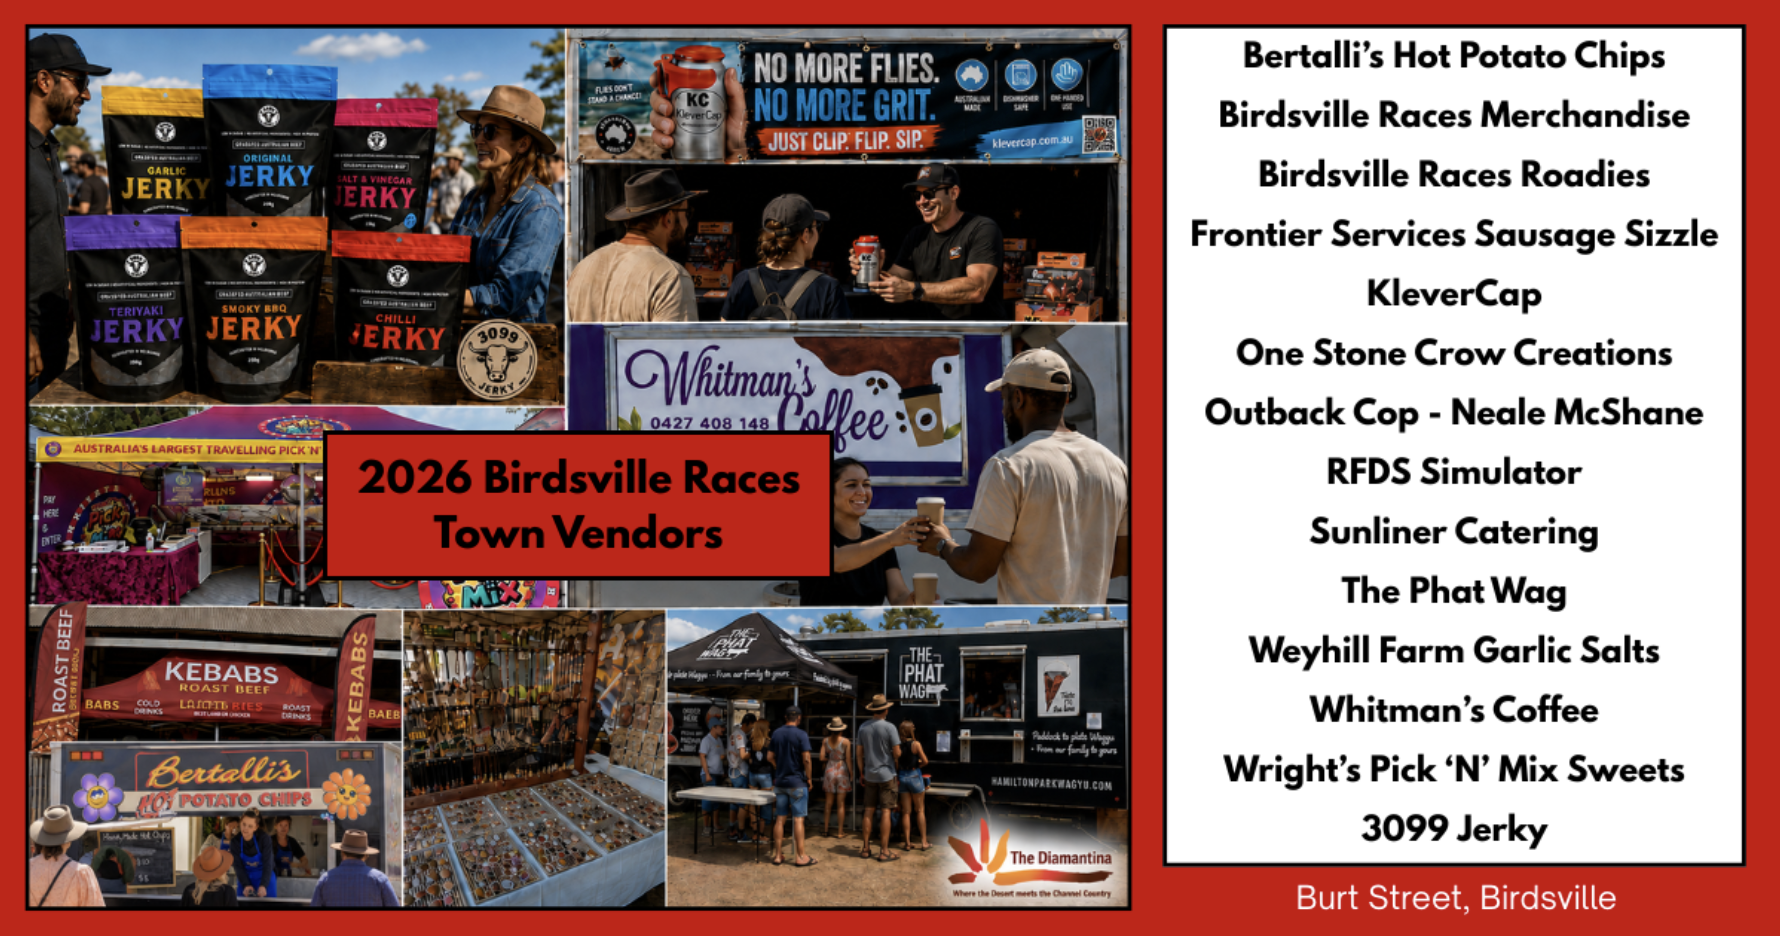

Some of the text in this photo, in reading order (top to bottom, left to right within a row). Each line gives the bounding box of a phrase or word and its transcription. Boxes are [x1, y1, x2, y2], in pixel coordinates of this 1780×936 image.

[754, 52, 940, 83] NO MORE FLIES.
[595, 85, 613, 94] FLIES
[686, 92, 709, 107] KC
[754, 87, 936, 121] NO MORE GRIT.
[954, 95, 991, 103] AUSTRALIAN
[964, 103, 982, 112] MADE
[1013, 103, 1029, 111] SAFE
[675, 108, 722, 121] KleverCap
[768, 129, 923, 151] JUST CLIP. FLIP. SIP.
[992, 135, 1074, 149] klevercap.com.au
[243, 154, 293, 163] ORIGINAL
[147, 166, 187, 175] GARLIC
[225, 165, 315, 187] JERKY
[337, 175, 413, 185] SALT & VINEGAR
[121, 177, 210, 199] JERKY
[334, 185, 417, 209] JERKY
[109, 305, 164, 317] TERIYAKI
[221, 303, 288, 314] SMOKY BBQ
[375, 313, 417, 324] CHILLI
[90, 317, 184, 343] JERKY
[205, 314, 303, 340] JERKY
[348, 323, 447, 351] JERKY
[477, 327, 519, 344] 3099
[624, 344, 816, 406] Whitman's
[479, 382, 514, 395] JERKY
[650, 417, 769, 430] 0427 408 148
[777, 387, 889, 453] Coffee
[73, 444, 148, 454] AUSTRALIA'S
[152, 444, 203, 455] LARGEST
[206, 445, 276, 455] TRAVELLING
[279, 445, 306, 455] PICK
[43, 495, 56, 504] PAY
[43, 508, 59, 518] HERE
[41, 534, 62, 547] ENTER
[730, 627, 755, 637] THE
[713, 638, 757, 648] PHAT
[52, 609, 73, 713] ROAST BEEF
[909, 646, 933, 663] THE
[164, 661, 279, 684] KEBABS
[905, 663, 944, 683] PHAT
[346, 631, 368, 732] KEBABS
[179, 683, 271, 694] ROAST BEEF
[85, 699, 120, 711] BABS
[137, 699, 160, 707] COLD
[282, 704, 311, 712] ROAST
[133, 707, 163, 716] DRINKS
[281, 712, 311, 721] DRINKS
[1032, 730, 1061, 741] Paddock
[1062, 731, 1069, 741] to
[1070, 731, 1088, 743] plate
[1036, 743, 1053, 754] From
[1067, 743, 1089, 758] family
[1090, 745, 1098, 754] to
[1098, 747, 1118, 758] yours
[145, 755, 301, 788] Bertalli's
[991, 776, 1113, 791] HAMILTONPARKWAGYU.COM
[135, 787, 313, 818] HOT POTATO CHIPS
